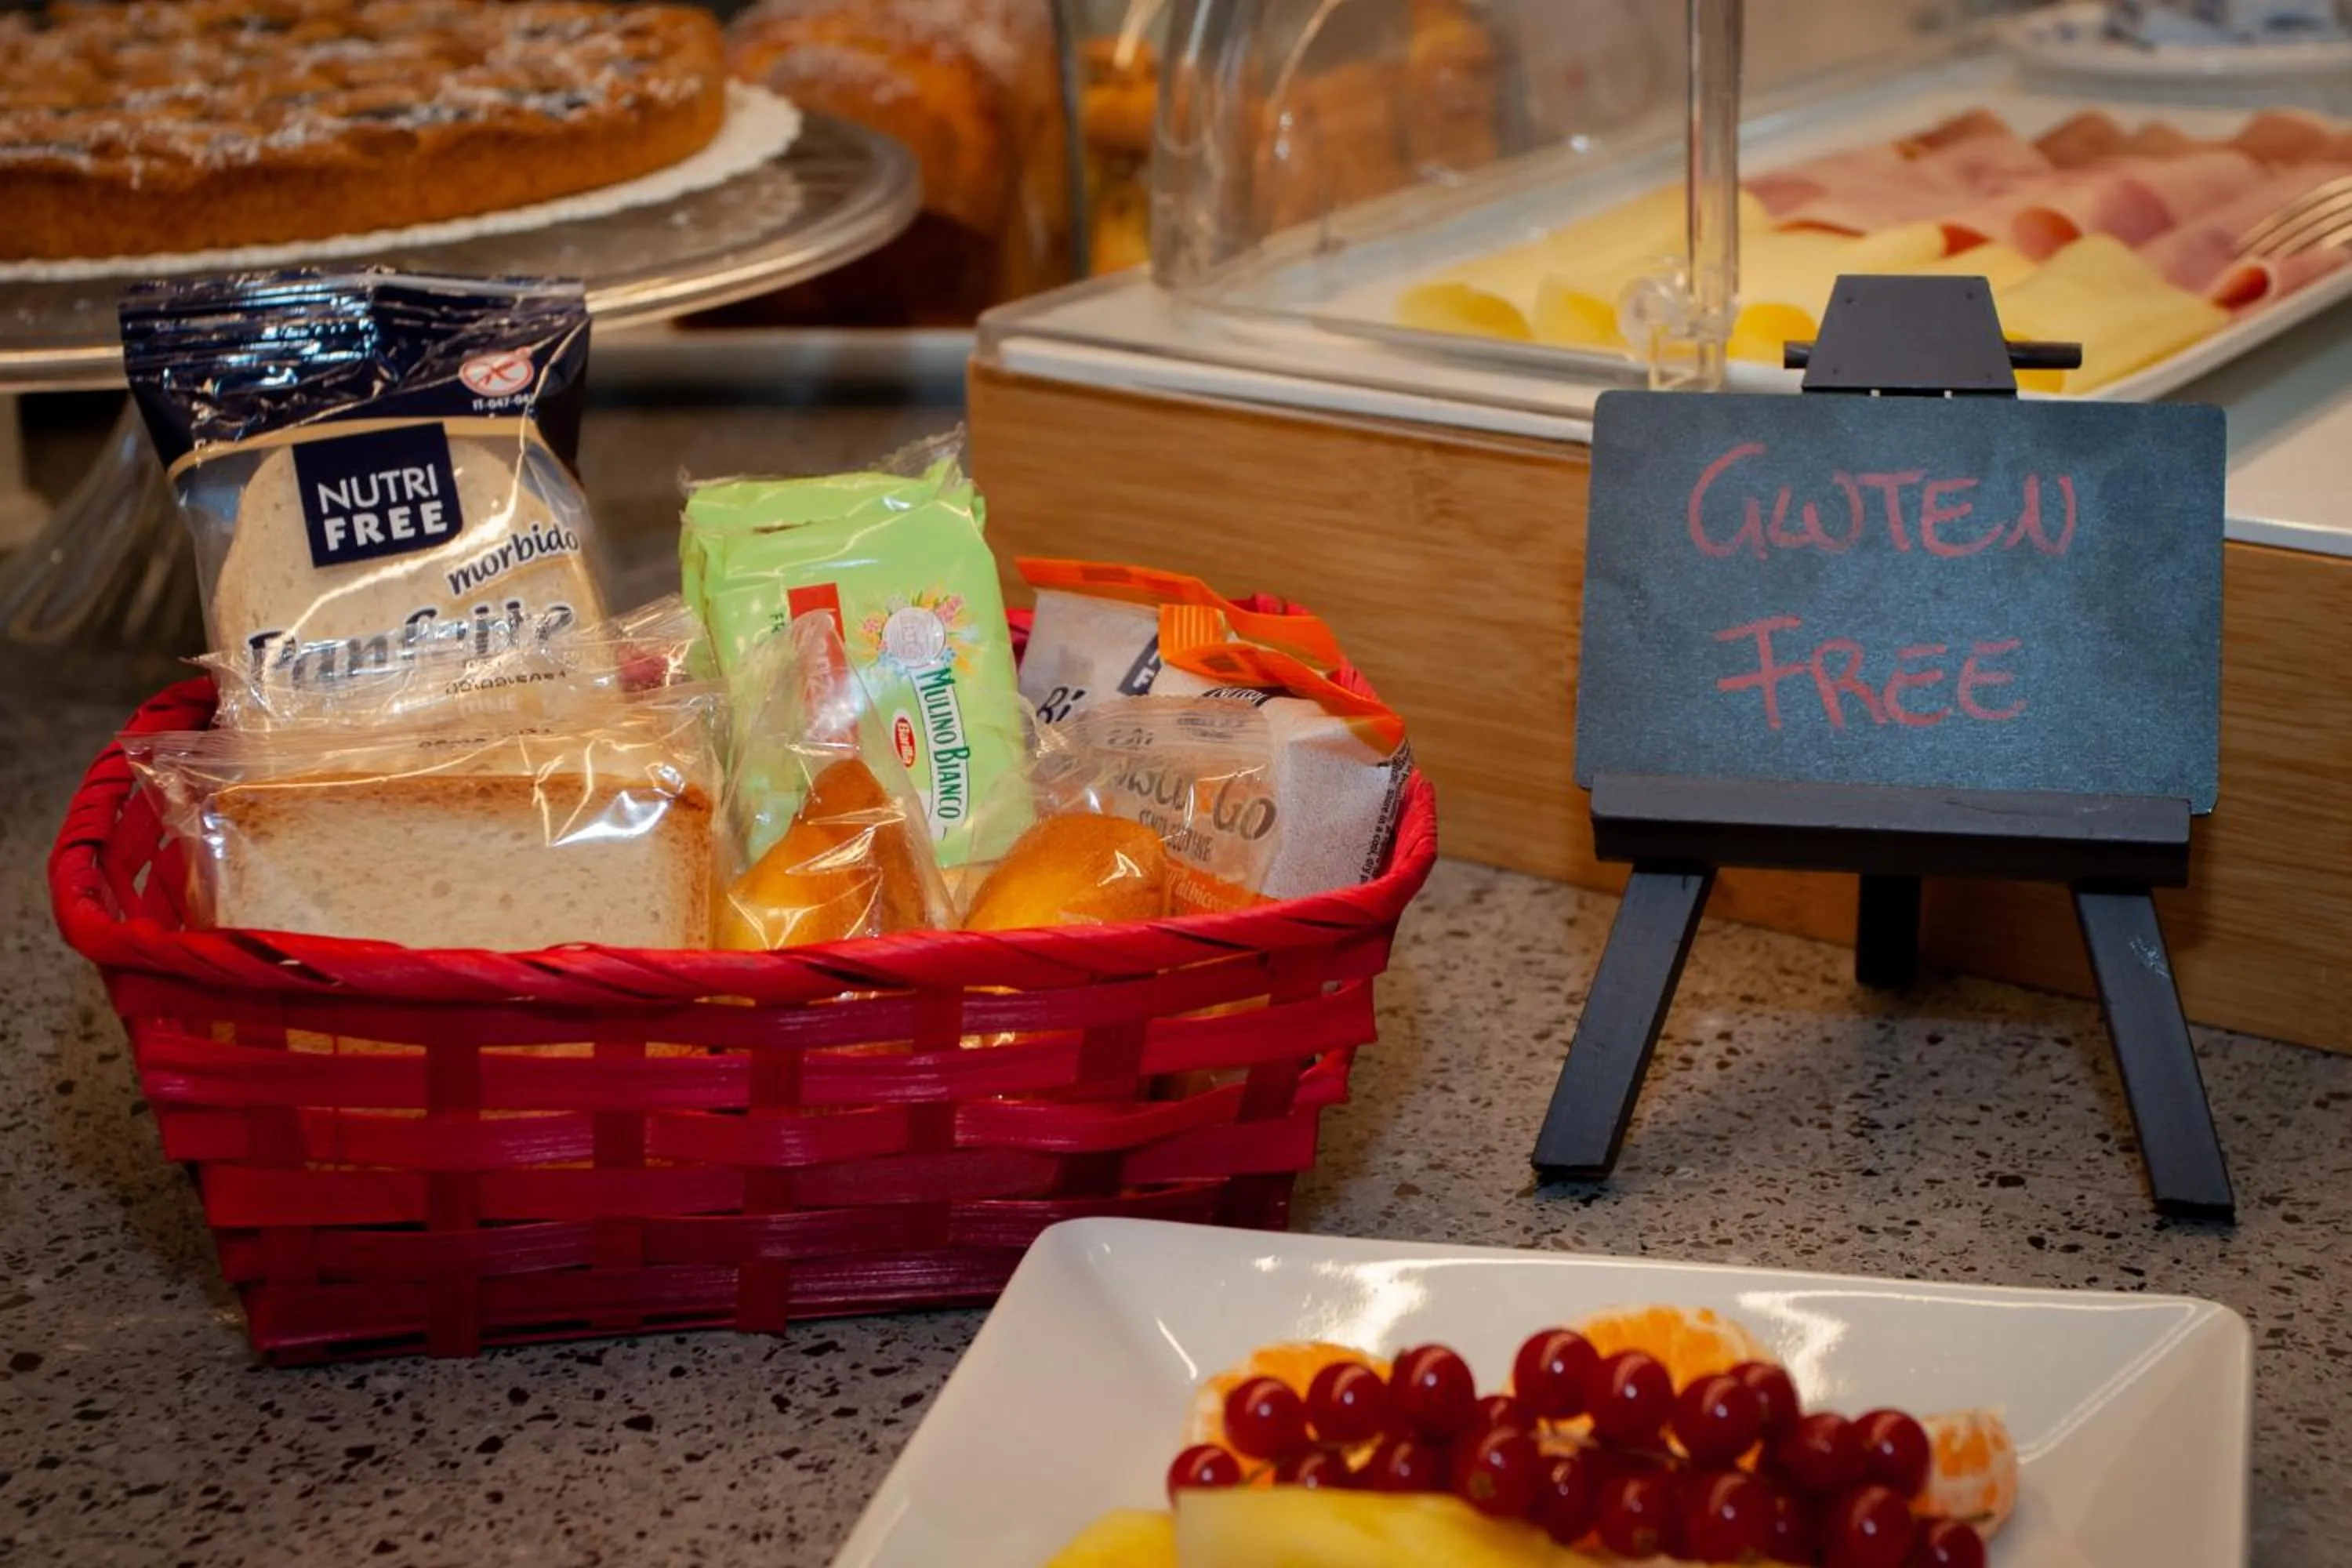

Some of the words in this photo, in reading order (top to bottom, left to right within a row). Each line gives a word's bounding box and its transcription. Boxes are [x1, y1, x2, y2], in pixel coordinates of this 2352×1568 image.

[316, 464, 437, 516] NUTRI
[1687, 442, 2076, 560] GLUTEN
[323, 502, 448, 552] FREE
[448, 524, 579, 597] morbido
[916, 667, 957, 745] MULINO
[1714, 615, 2027, 729] FREE
[933, 746, 971, 819] BIANCO
